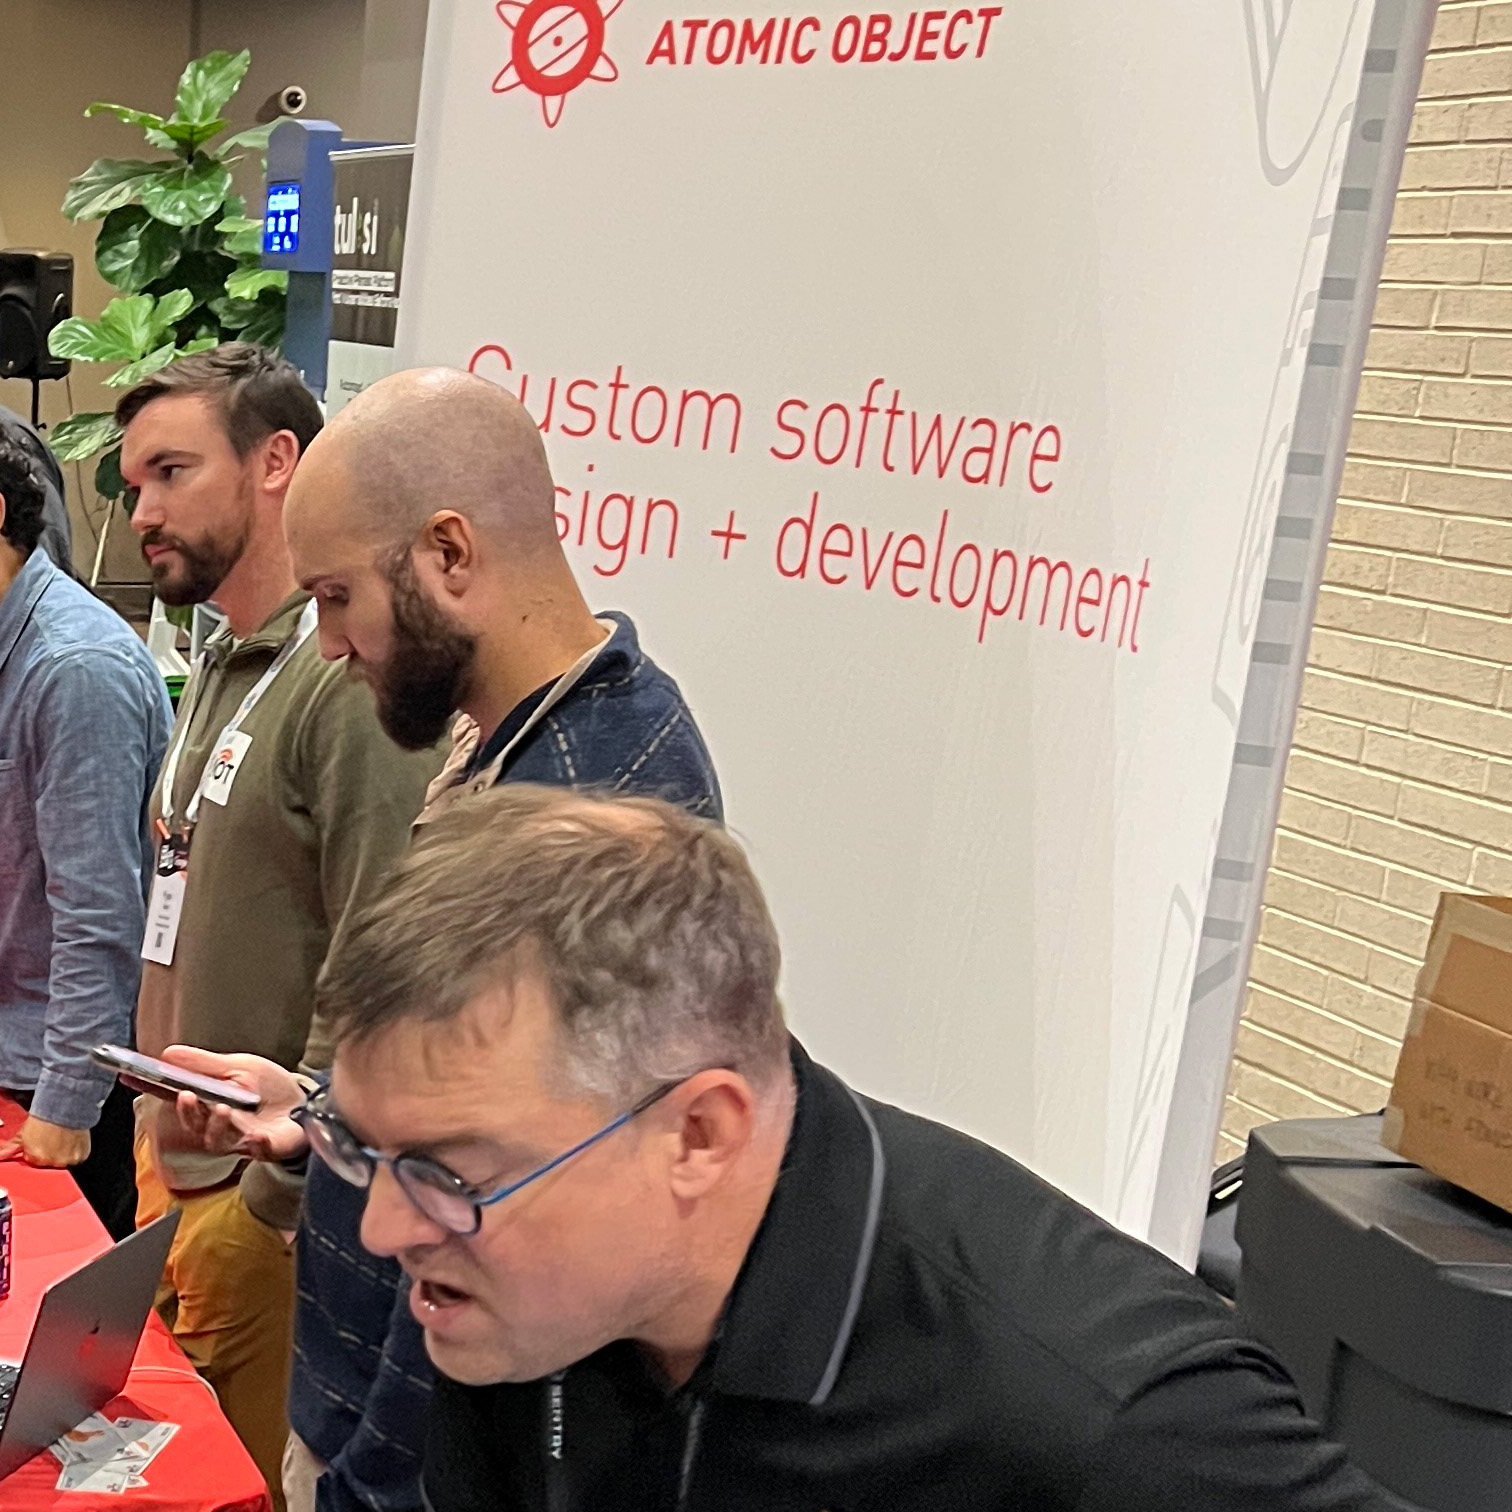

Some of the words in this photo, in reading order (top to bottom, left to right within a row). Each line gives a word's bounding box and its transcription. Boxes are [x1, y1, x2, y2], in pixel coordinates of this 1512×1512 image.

[645, 16, 821, 65] ATOMIC
[831, 6, 1003, 63] OBJECT
[770, 377, 1062, 493] software
[553, 463, 679, 577] sign
[775, 490, 1150, 653] development
